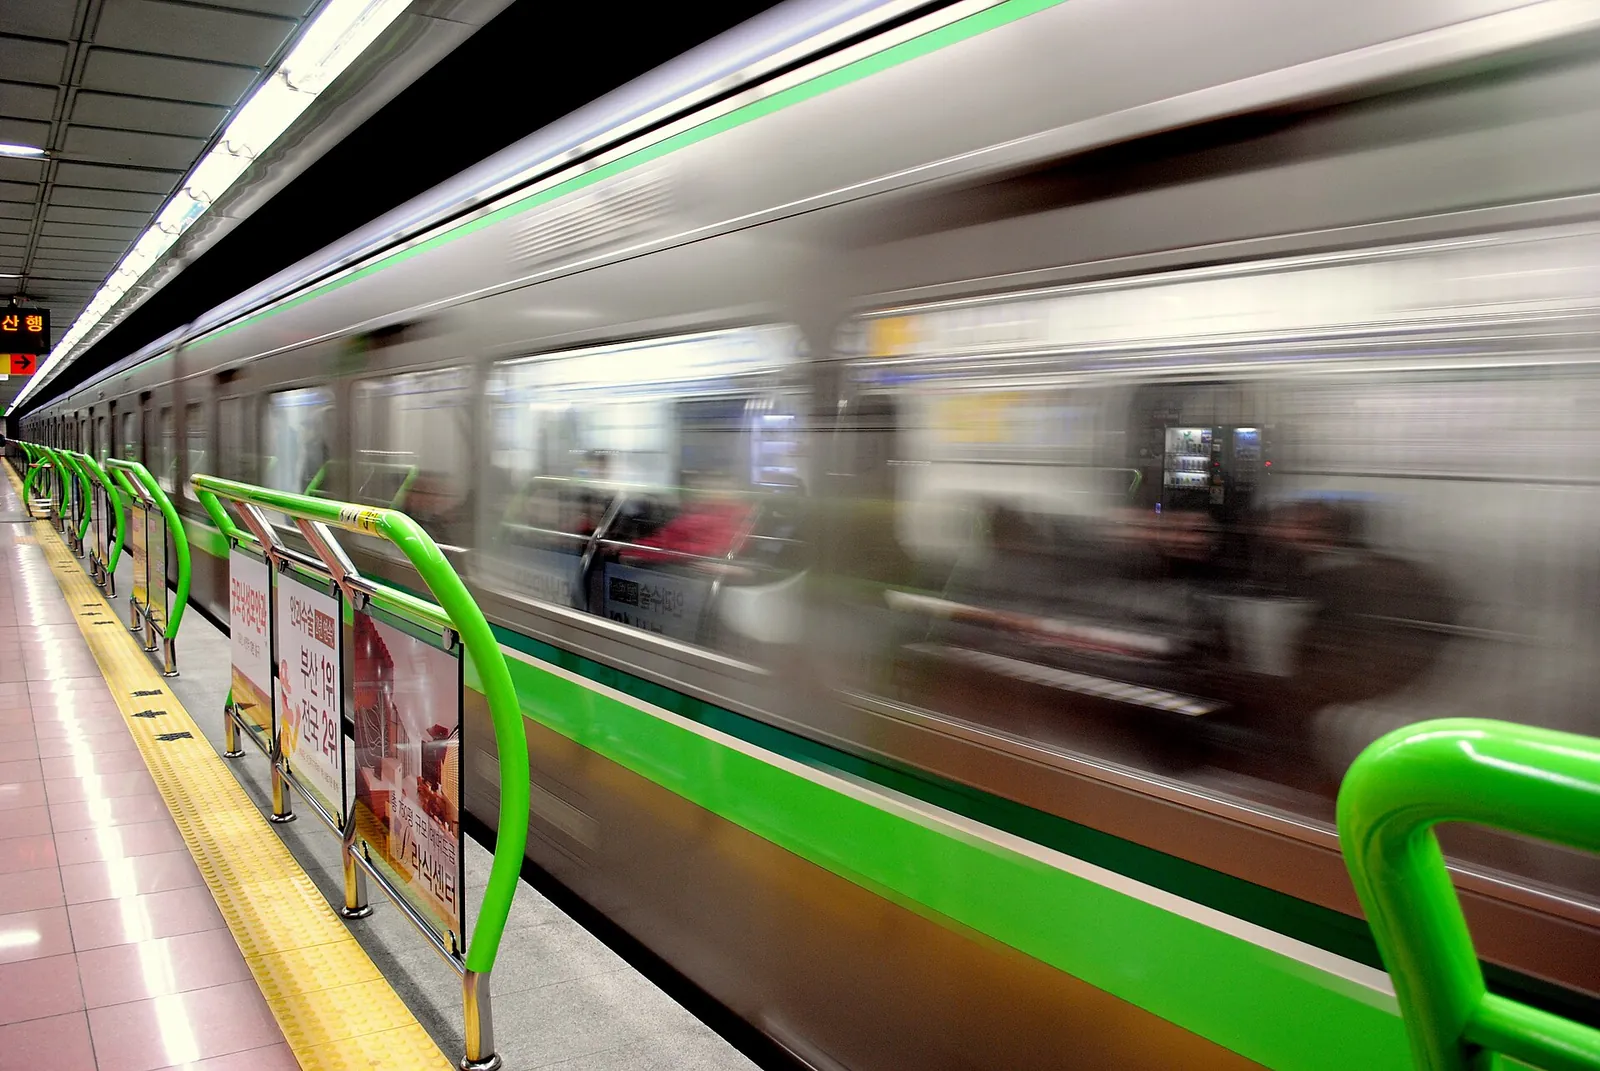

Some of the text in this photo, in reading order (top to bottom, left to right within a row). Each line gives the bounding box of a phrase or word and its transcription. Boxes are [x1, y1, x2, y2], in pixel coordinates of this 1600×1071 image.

[289, 596, 314, 638] 안과수술
[300, 645, 318, 697] 부산
[321, 654, 336, 712] 1위
[301, 698, 319, 752] 전국
[321, 709, 338, 770] 2위
[415, 814, 428, 839] 규모
[410, 841, 457, 915] 라식센터
